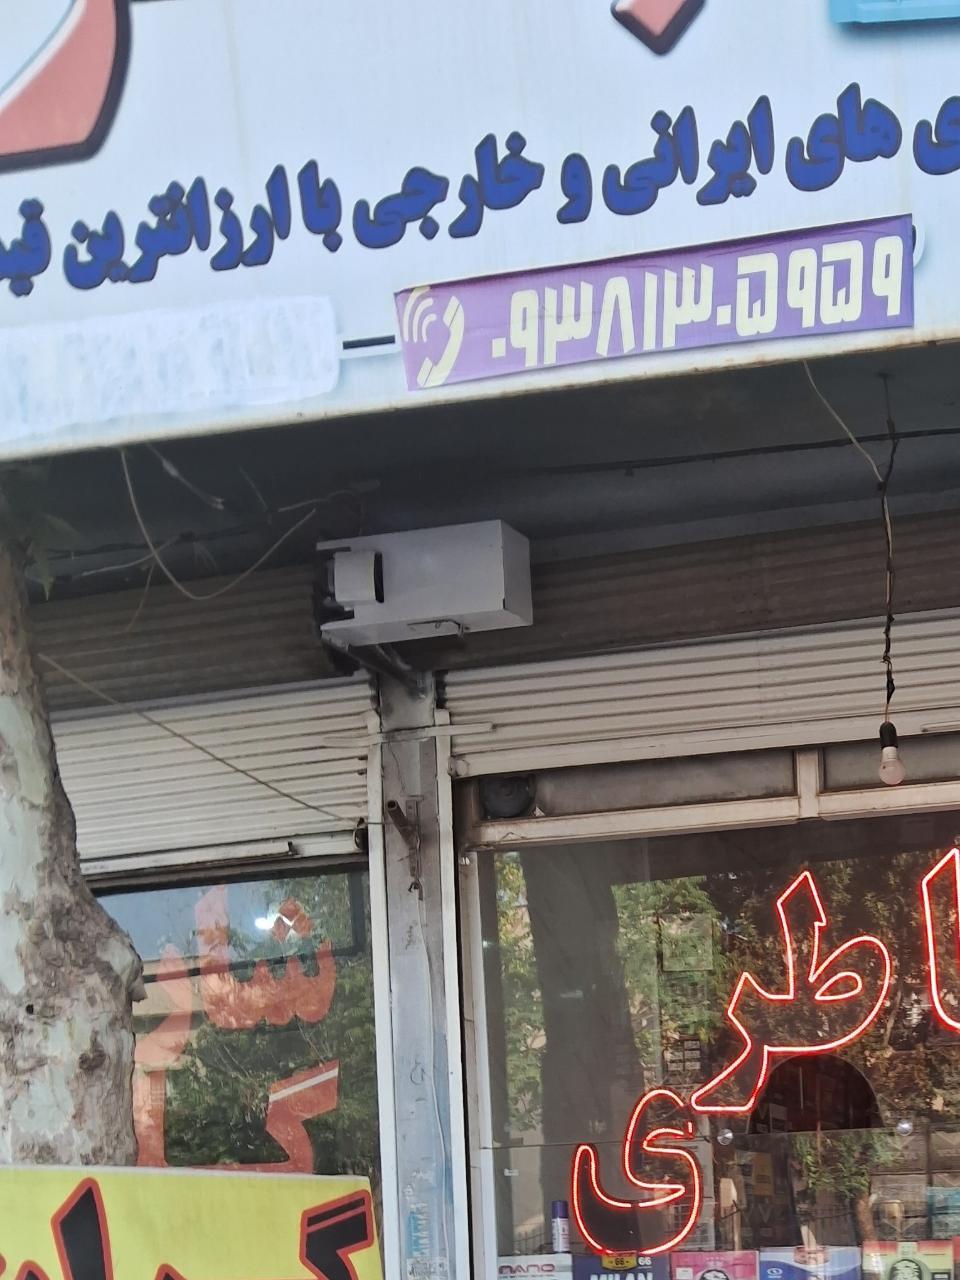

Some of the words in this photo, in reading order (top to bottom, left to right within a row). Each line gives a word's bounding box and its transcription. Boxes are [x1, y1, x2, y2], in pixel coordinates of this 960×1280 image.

[352, 130, 545, 250] خارجی
[556, 152, 593, 225] و
[601, 94, 776, 216] ایرانی
[785, 81, 903, 193] های
[296, 158, 344, 253] با
[491, 234, 905, 370] ۰۹۳۸۱۳۰۵۹۵۹
